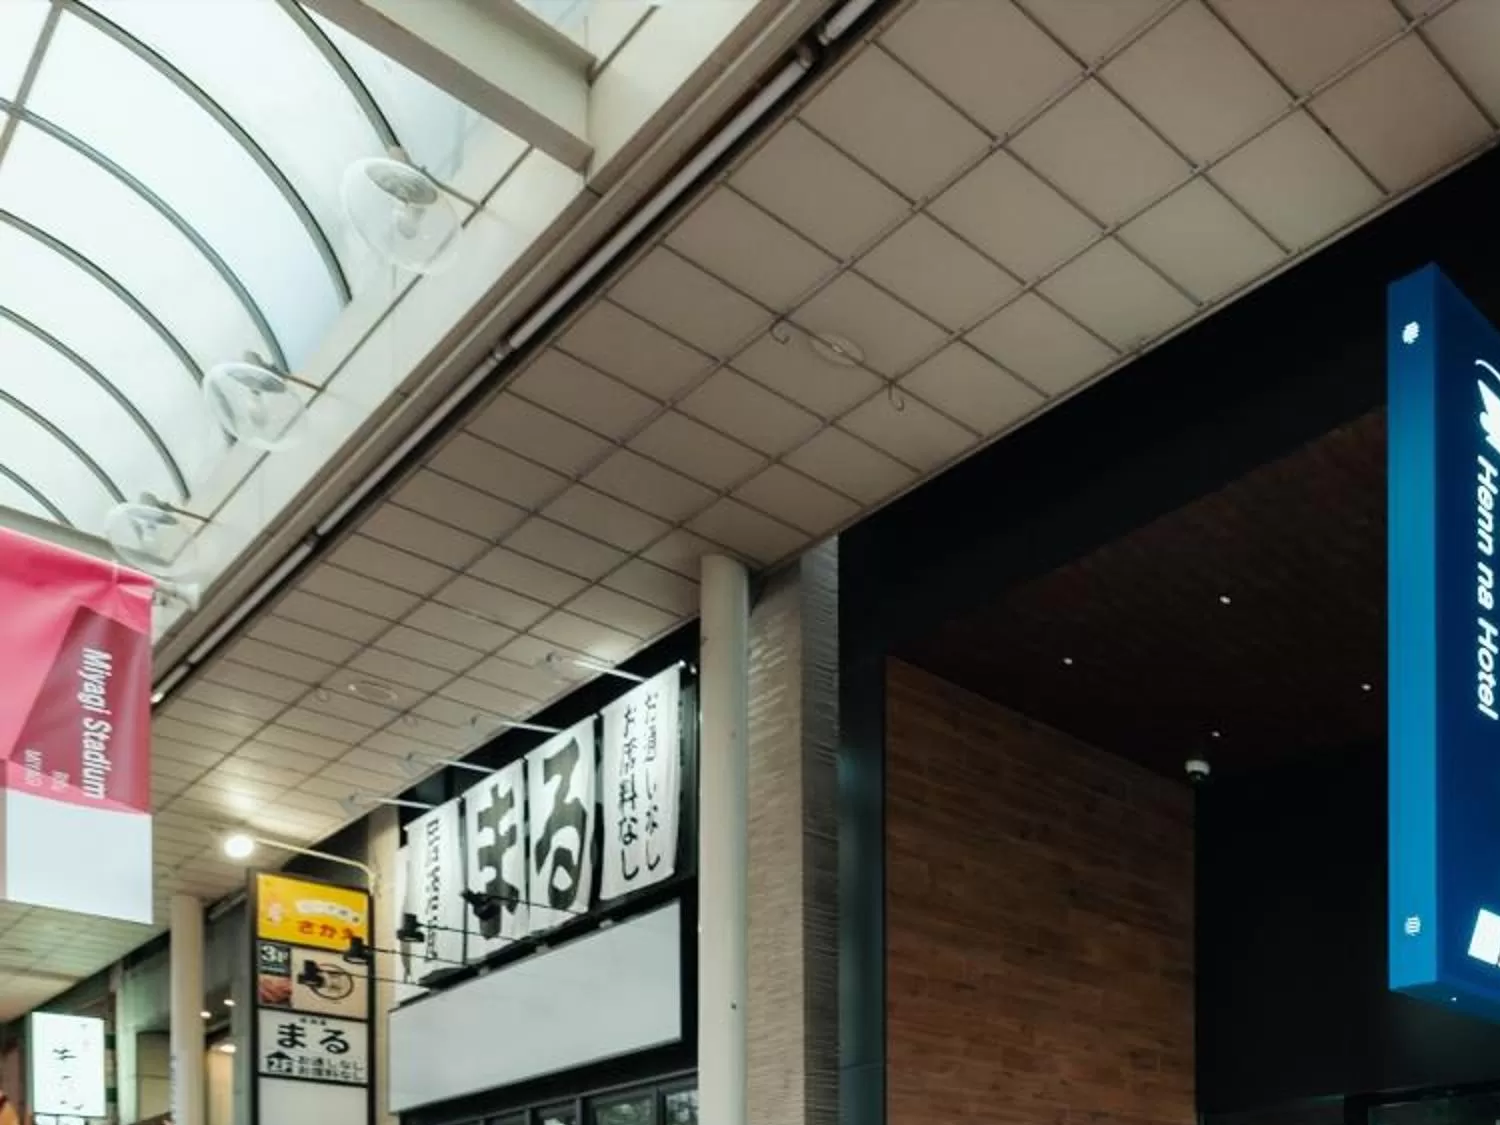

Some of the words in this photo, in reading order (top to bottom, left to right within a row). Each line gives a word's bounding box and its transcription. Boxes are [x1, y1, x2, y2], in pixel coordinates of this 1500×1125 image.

[1477, 454, 1499, 556] Henn
[1477, 562, 1496, 611] na
[76, 647, 113, 716] Miyagi
[1477, 615, 1500, 721] Hotel
[82, 716, 113, 800] Stadium
[277, 1022, 351, 1055] まる
